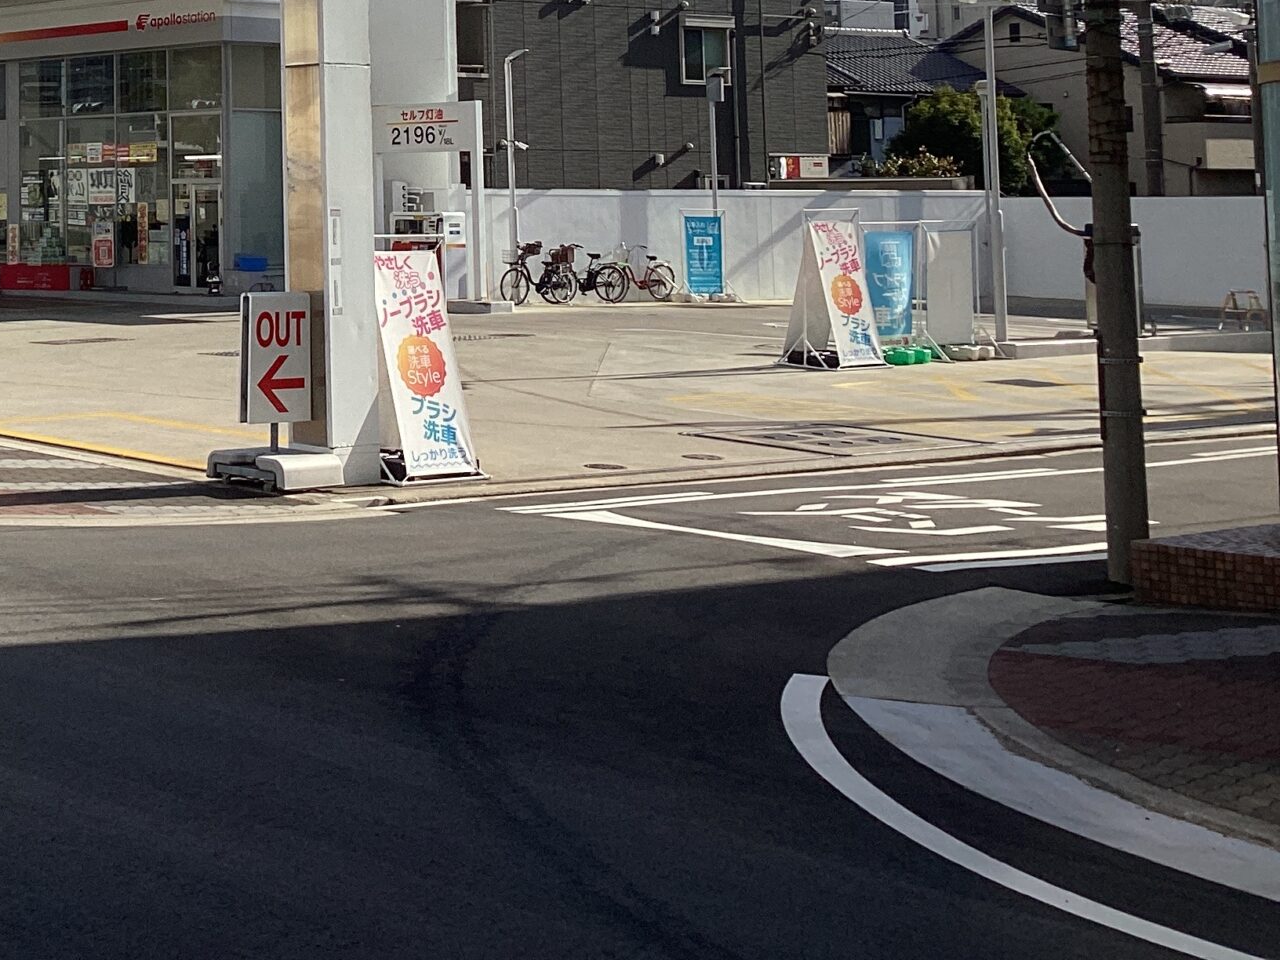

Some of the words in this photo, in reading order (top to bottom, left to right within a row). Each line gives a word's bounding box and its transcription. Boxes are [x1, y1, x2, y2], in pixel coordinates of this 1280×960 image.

[150, 10, 216, 29] apollostation
[400, 108, 444, 121] セルフ灯油
[391, 126, 436, 145] 2196
[375, 255, 413, 270] やさしく
[820, 244, 857, 271] ノーブラシ
[839, 257, 861, 276] 洗車
[394, 270, 421, 289] 洗う
[381, 290, 440, 328] ノーブラシ
[838, 296, 861, 309] Style
[256, 310, 306, 348] OUT
[411, 309, 447, 337] 洗車
[841, 315, 870, 332] ブラシ
[408, 355, 432, 369] 洗車
[407, 369, 441, 387] Style
[411, 396, 457, 422] ブラシ
[423, 419, 458, 446] 洗車
[412, 447, 469, 464] しっかり洗う
